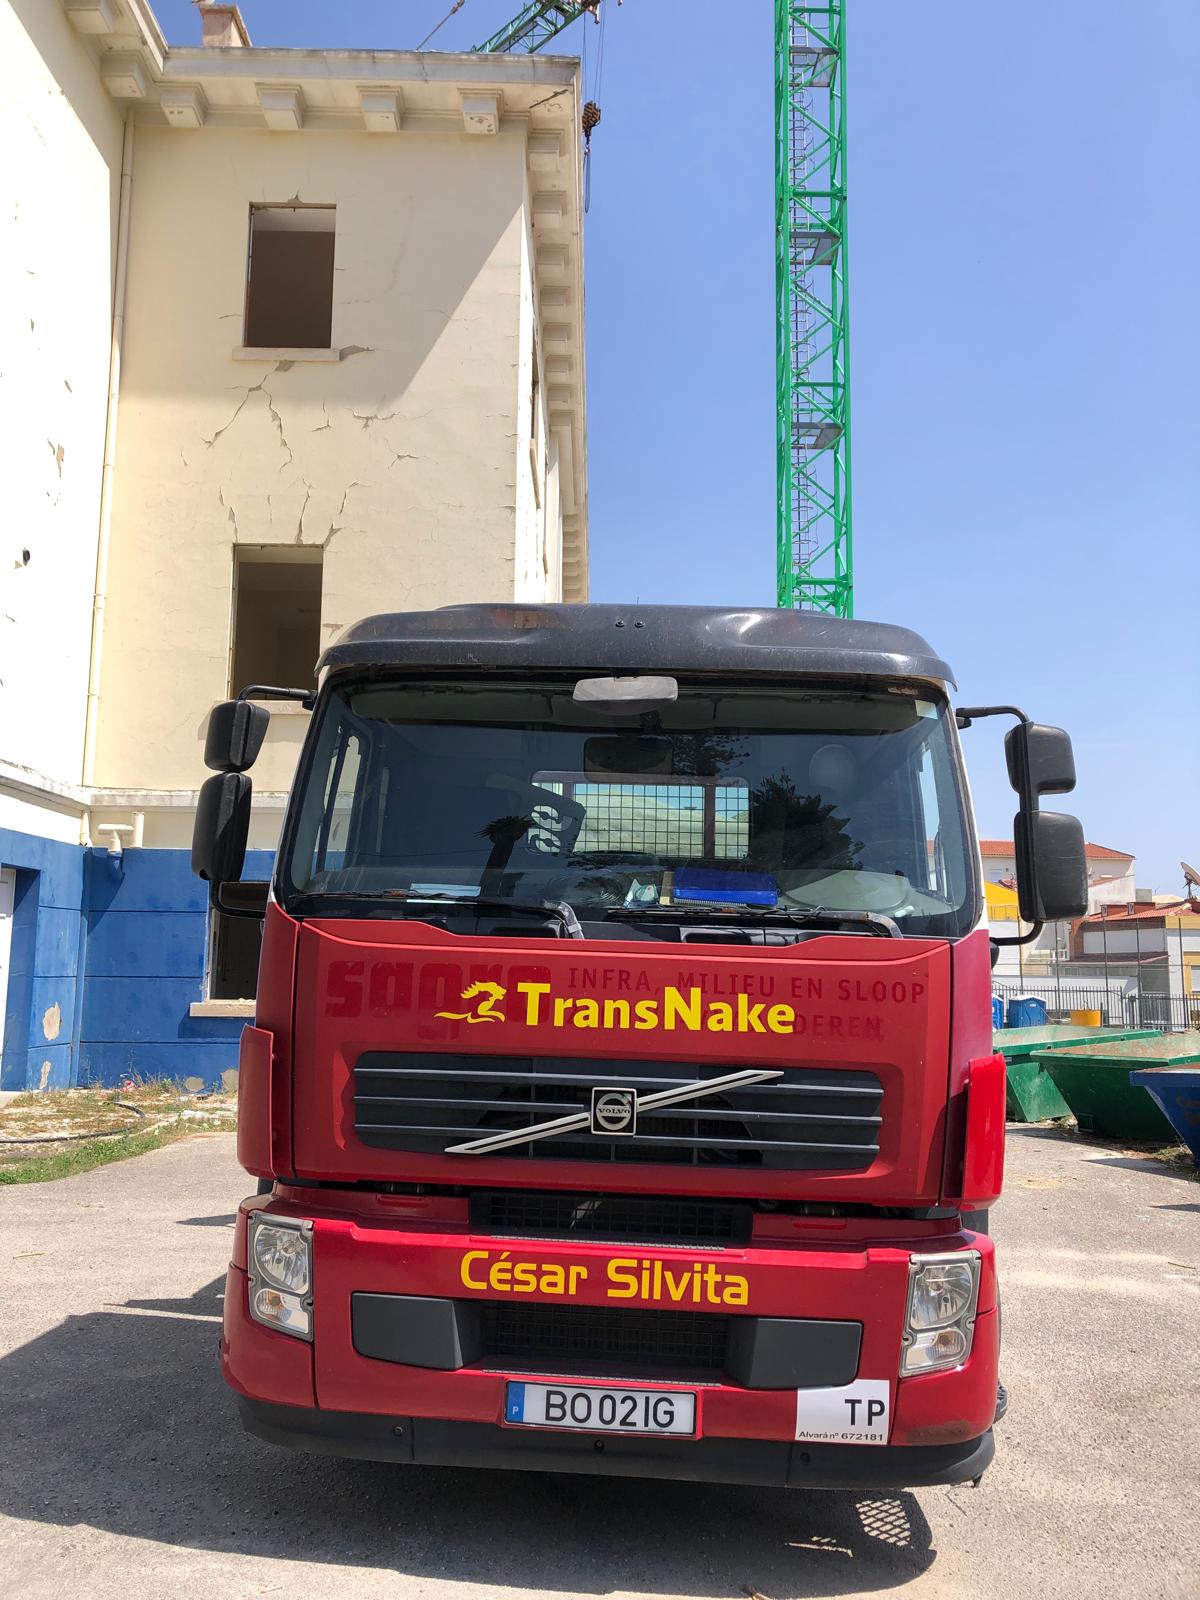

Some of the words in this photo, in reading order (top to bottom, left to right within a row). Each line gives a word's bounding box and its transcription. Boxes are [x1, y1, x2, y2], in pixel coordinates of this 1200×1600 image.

[676, 971, 775, 997] MILIEU
[790, 976, 823, 1000] EN
[837, 979, 925, 1003] SLOOP
[516, 981, 796, 1034] TransNake
[598, 1107, 631, 1115] VOLVO
[460, 1250, 588, 1295] César
[606, 1258, 749, 1306] Silvita
[512, 1406, 519, 1415] P
[840, 1432, 884, 1442] 672181
